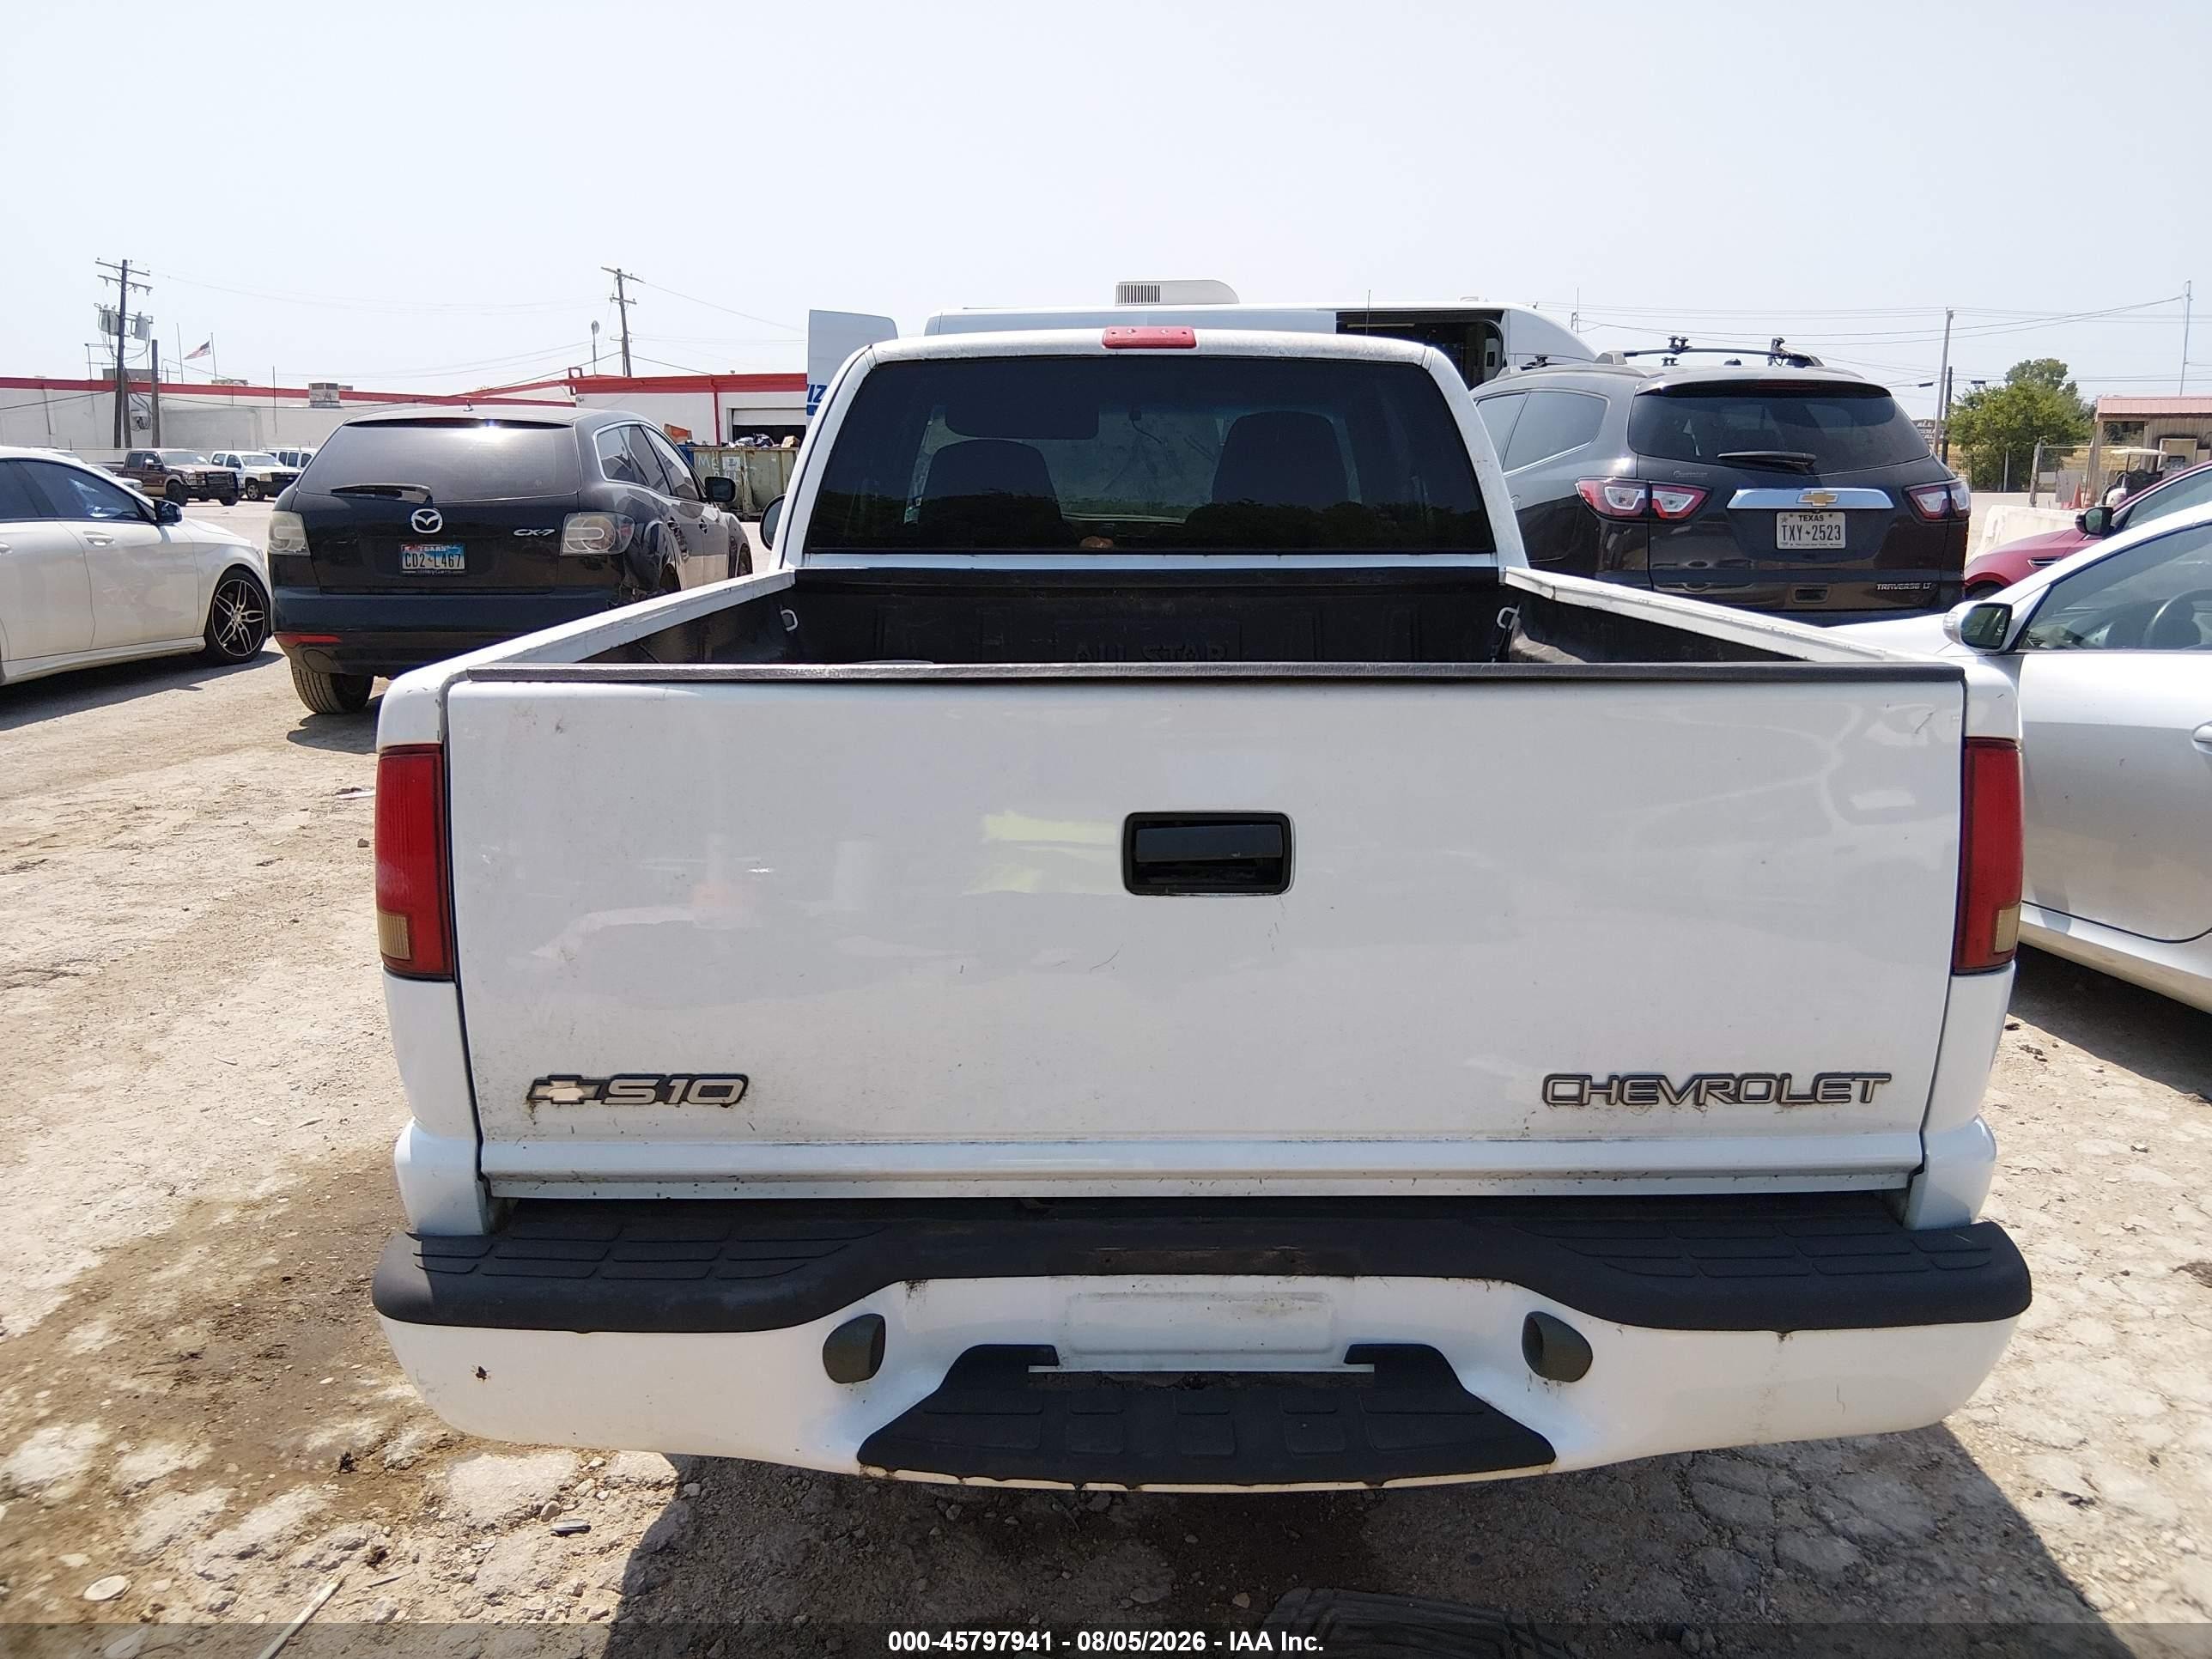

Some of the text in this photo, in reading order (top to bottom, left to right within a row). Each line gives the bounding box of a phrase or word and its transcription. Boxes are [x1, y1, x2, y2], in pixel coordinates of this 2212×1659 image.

[514, 528, 556, 537] CX-7
[1875, 581, 1932, 591] TRAVERSE LT
[602, 1075, 749, 1105] S10
[1542, 1073, 1892, 1106] CHEVROLET
